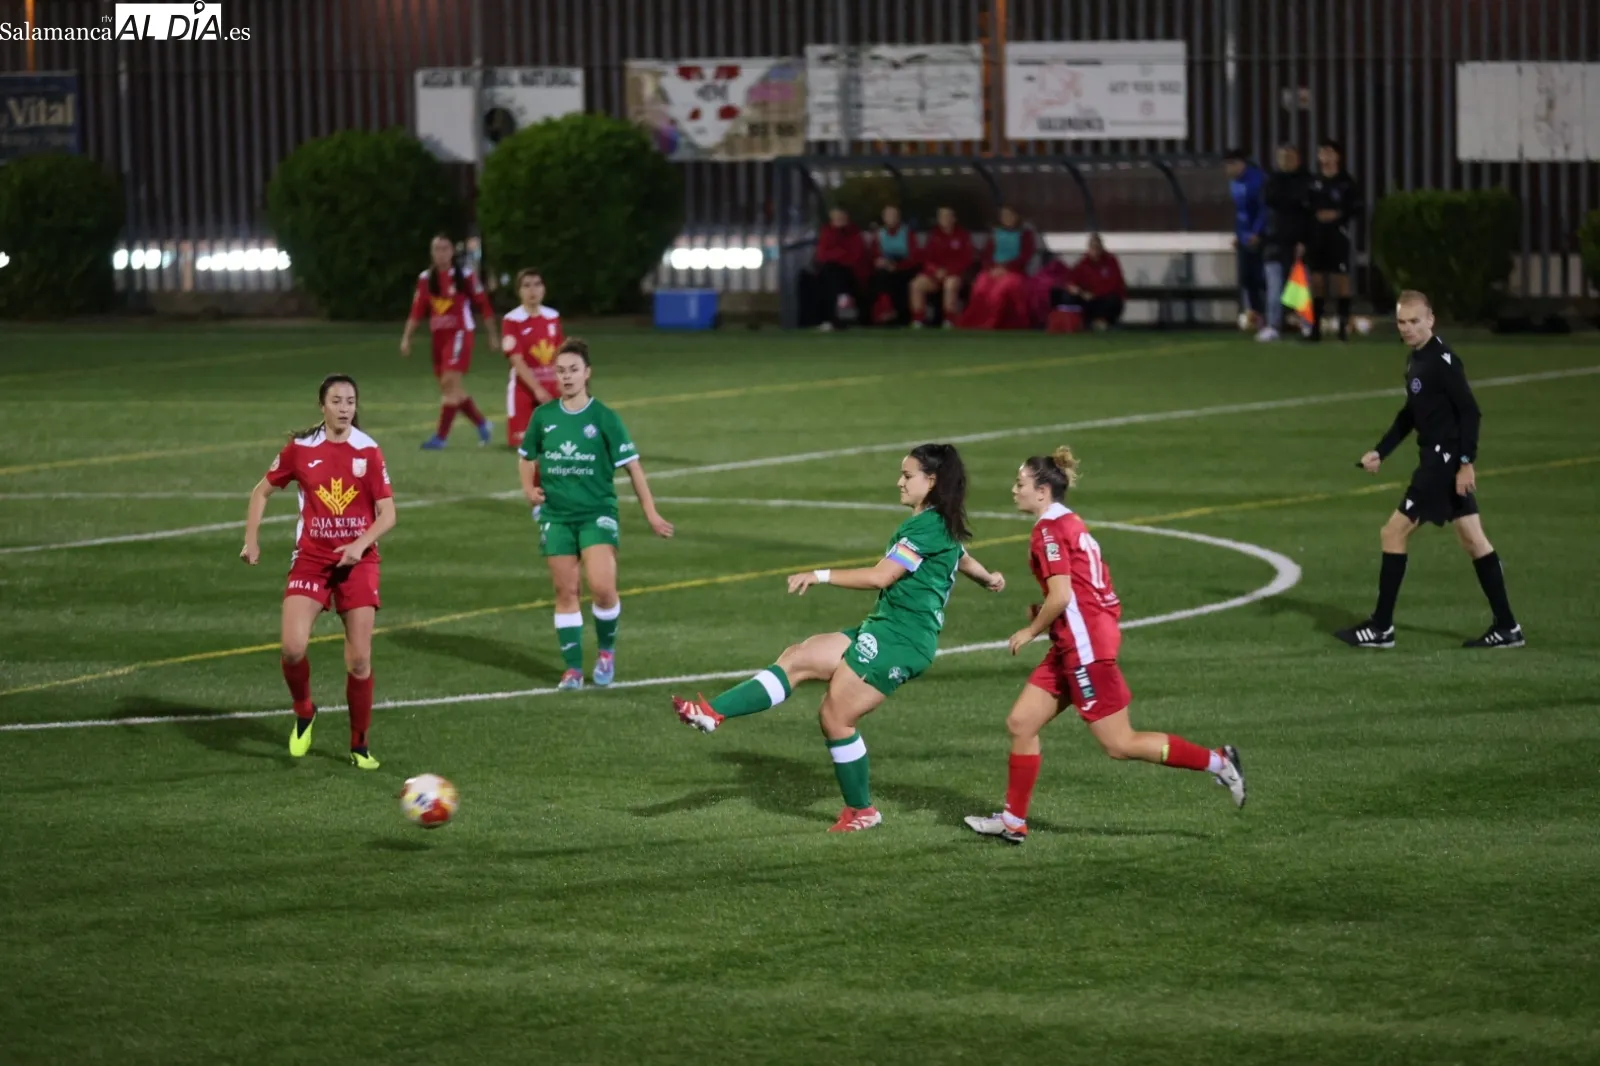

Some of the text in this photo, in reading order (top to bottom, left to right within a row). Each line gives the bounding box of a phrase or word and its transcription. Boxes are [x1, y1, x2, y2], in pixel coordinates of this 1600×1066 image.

[6, 92, 76, 128] Vital
[311, 516, 368, 530] CAJA RURAL
